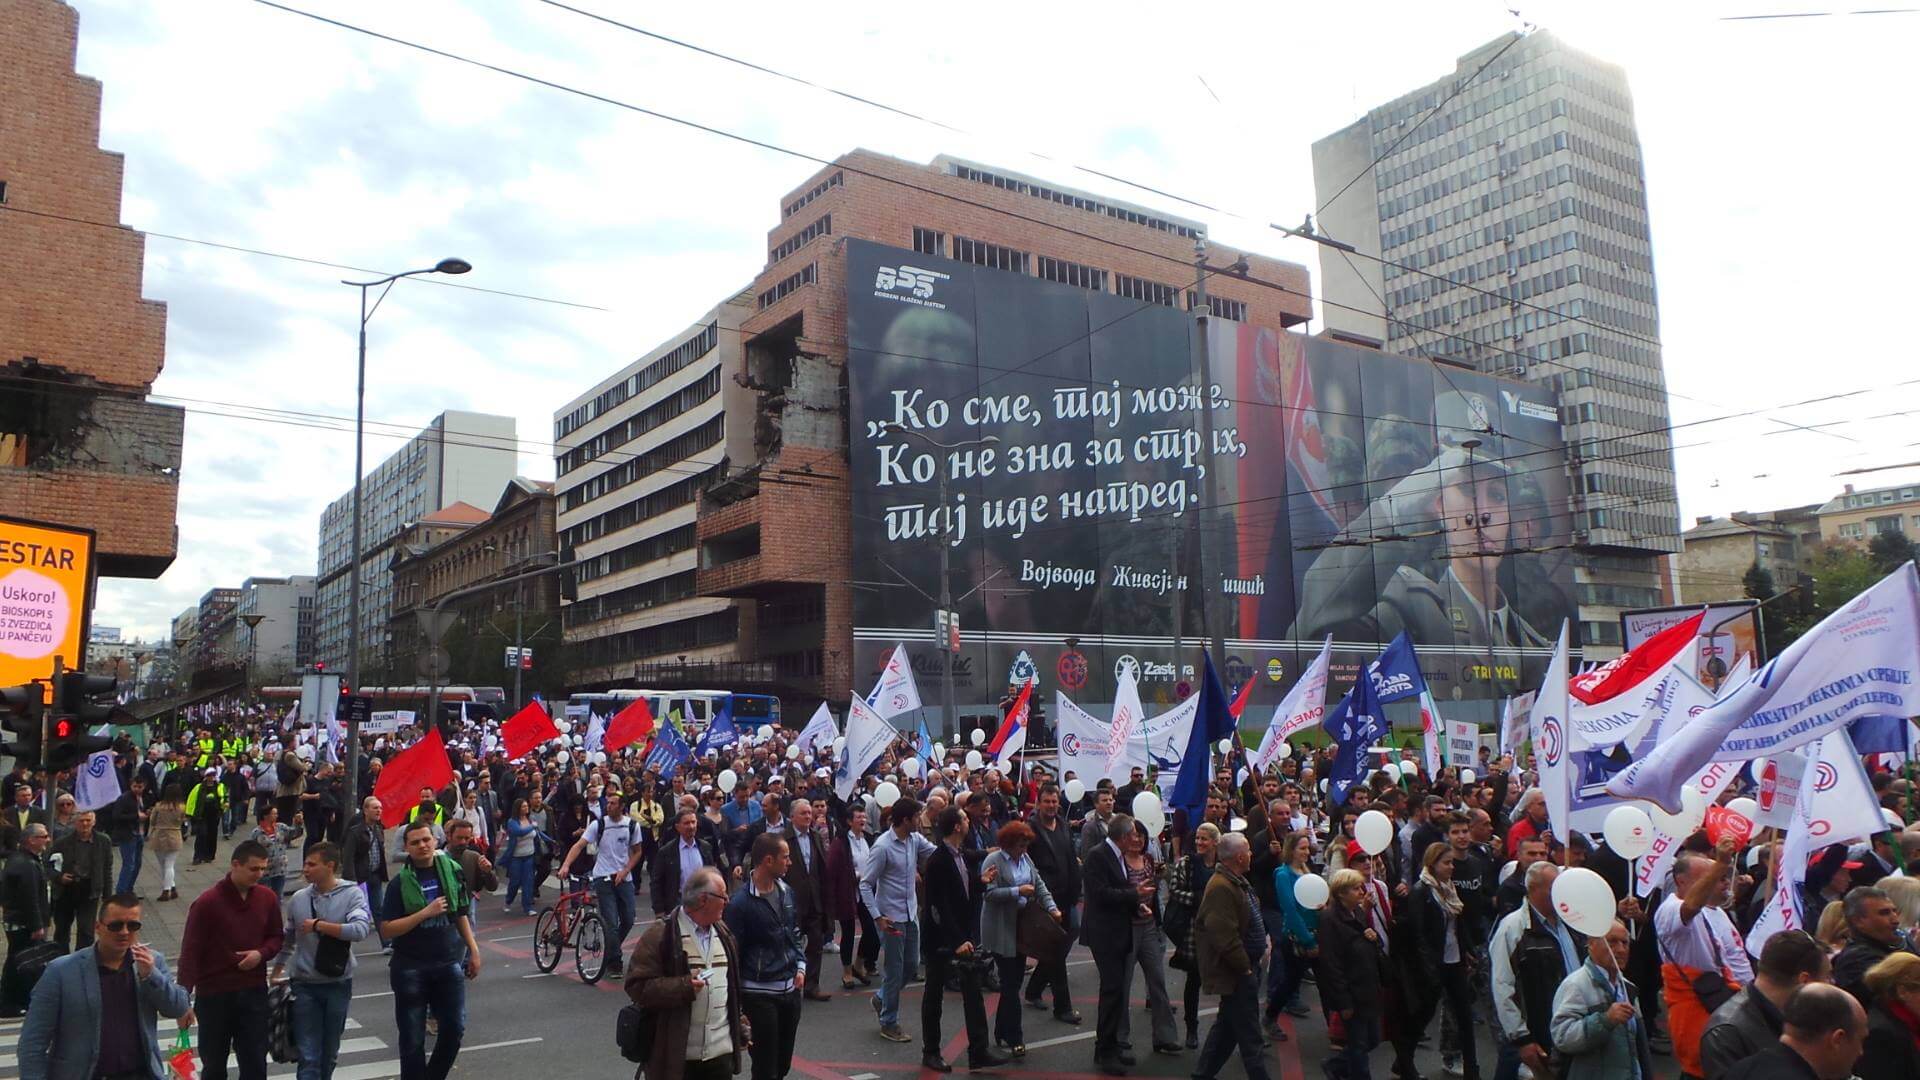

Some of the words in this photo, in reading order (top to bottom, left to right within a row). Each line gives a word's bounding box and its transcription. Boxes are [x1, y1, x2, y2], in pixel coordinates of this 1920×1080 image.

[963, 395, 1042, 427] сме,
[1132, 384, 1230, 415] може.
[876, 443, 936, 486] Ко
[948, 448, 996, 480] не
[1007, 441, 1075, 474] зна
[1086, 438, 1125, 466] за
[1134, 428, 1248, 469] стрх,
[982, 495, 1049, 539] иде
[1058, 480, 1199, 523] напред.
[1021, 559, 1096, 591] Војвода
[1214, 574, 1265, 595] ишић
[2, 586, 56, 604] Uskoro!
[1, 605, 46, 618] BIOSKOPI
[8, 619, 52, 631] ZVEZDICA
[8, 629, 52, 643] PANČEVU
[1143, 661, 1195, 675] Zasta
[1472, 666, 1518, 680] TRYAL
